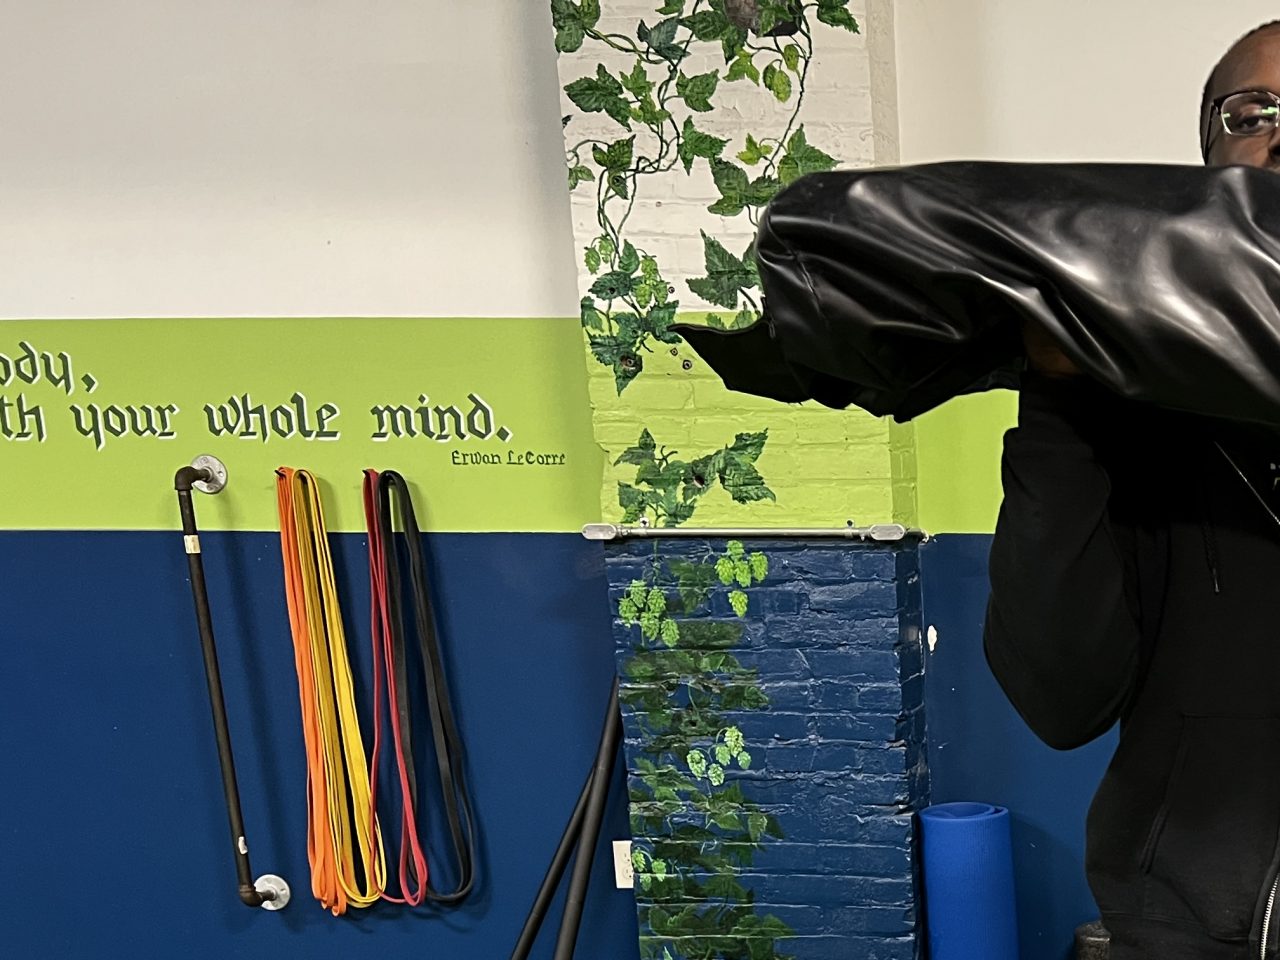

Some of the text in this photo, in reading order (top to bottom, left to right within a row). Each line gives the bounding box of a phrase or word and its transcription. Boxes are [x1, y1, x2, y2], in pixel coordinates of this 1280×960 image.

[69, 403, 180, 451] your
[203, 391, 341, 444] whole
[370, 392, 513, 443] mind.
[451, 449, 501, 465] Erwan
